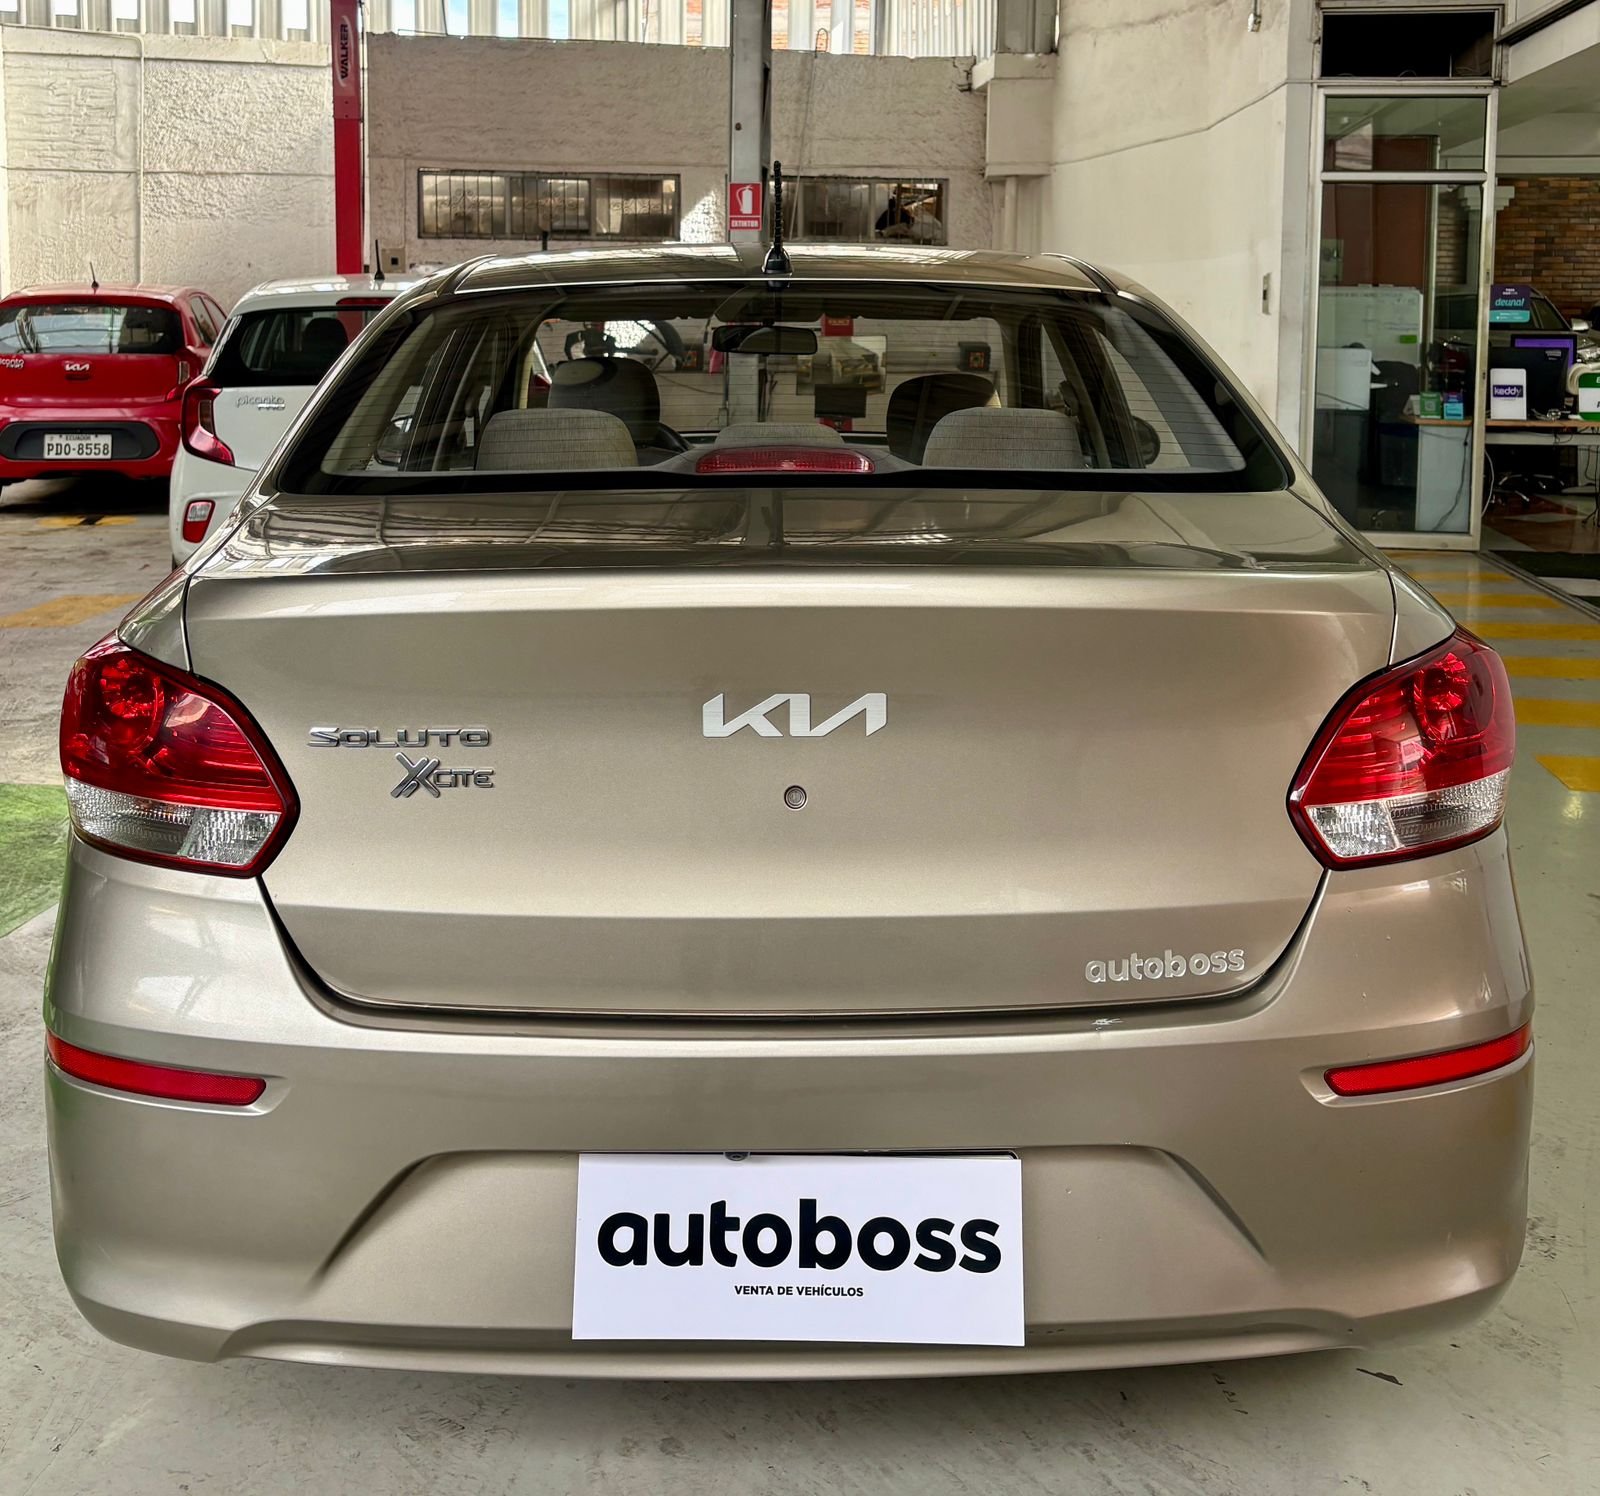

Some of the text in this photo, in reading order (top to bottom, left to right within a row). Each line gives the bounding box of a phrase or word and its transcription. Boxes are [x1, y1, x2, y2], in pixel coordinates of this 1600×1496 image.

[340, 24, 349, 80] WALKER
[1494, 386, 1522, 397] keddy
[47, 443, 110, 456] PDO-8558
[702, 692, 888, 738] KIA
[1085, 949, 1245, 983] autoboss
[597, 1198, 1002, 1274] autoboss
[734, 1283, 865, 1298] VENTA DE VEHÍCULOS
